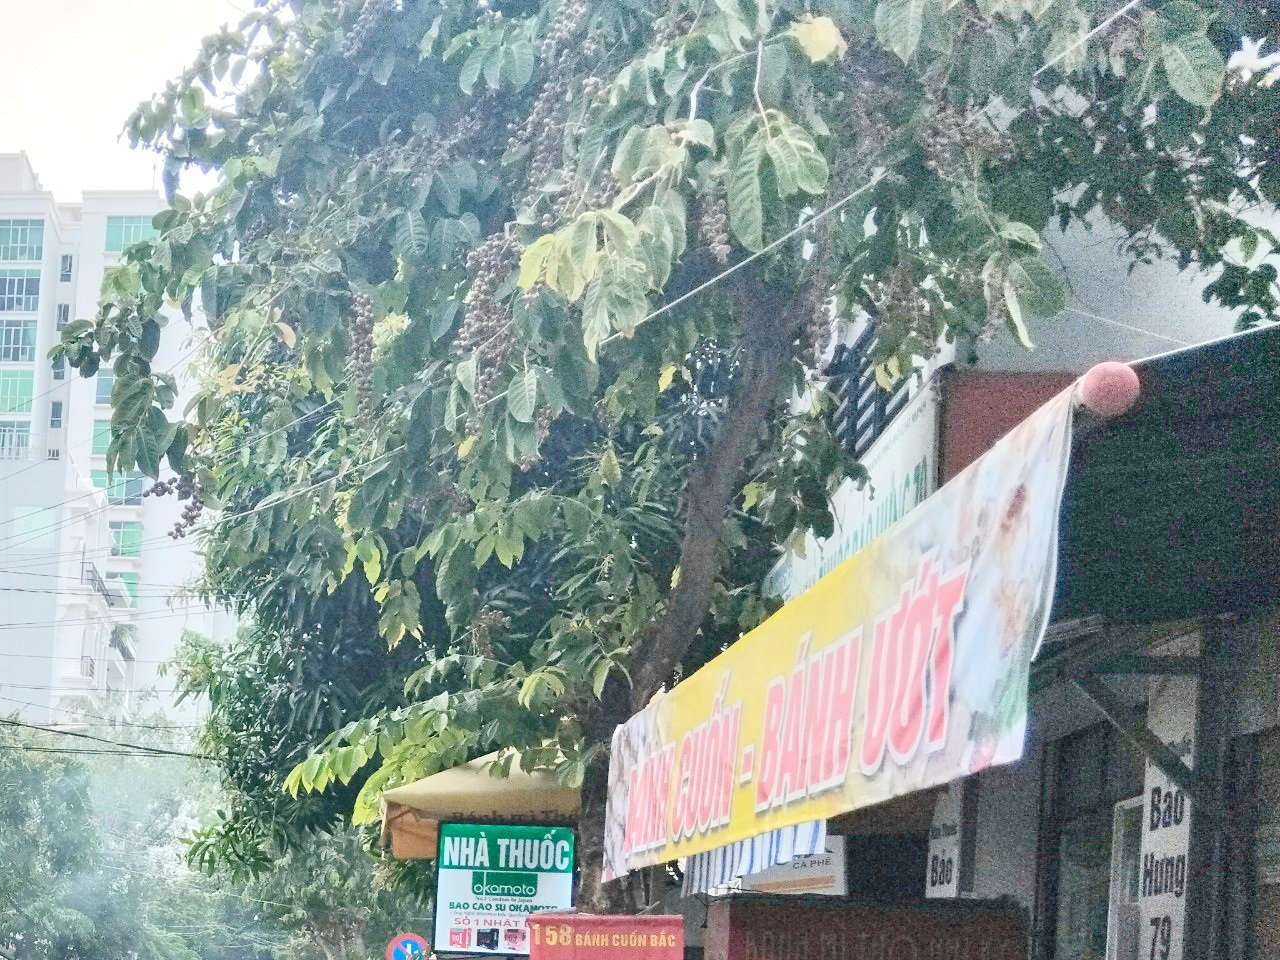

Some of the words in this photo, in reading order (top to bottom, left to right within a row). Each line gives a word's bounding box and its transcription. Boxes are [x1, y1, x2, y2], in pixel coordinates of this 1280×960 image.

[671, 669, 742, 844] CUỐN
[754, 625, 863, 816] BÁNH
[858, 546, 971, 777] ƯỚT
[443, 832, 490, 867] NHÀ
[496, 829, 570, 870] THUỐC
[810, 856, 832, 867] PHÊ
[473, 876, 536, 896] okamoto
[449, 901, 469, 910] BAO
[472, 902, 493, 911] CAO
[495, 903, 506, 911] SU
[454, 916, 471, 926] SỐ
[483, 918, 520, 928] NHẬT
[532, 923, 572, 946] 158
[575, 931, 609, 947] BÁNH
[612, 930, 647, 947] CUỐN
[650, 930, 676, 947] BẮC
[1150, 915, 1171, 960] 79
